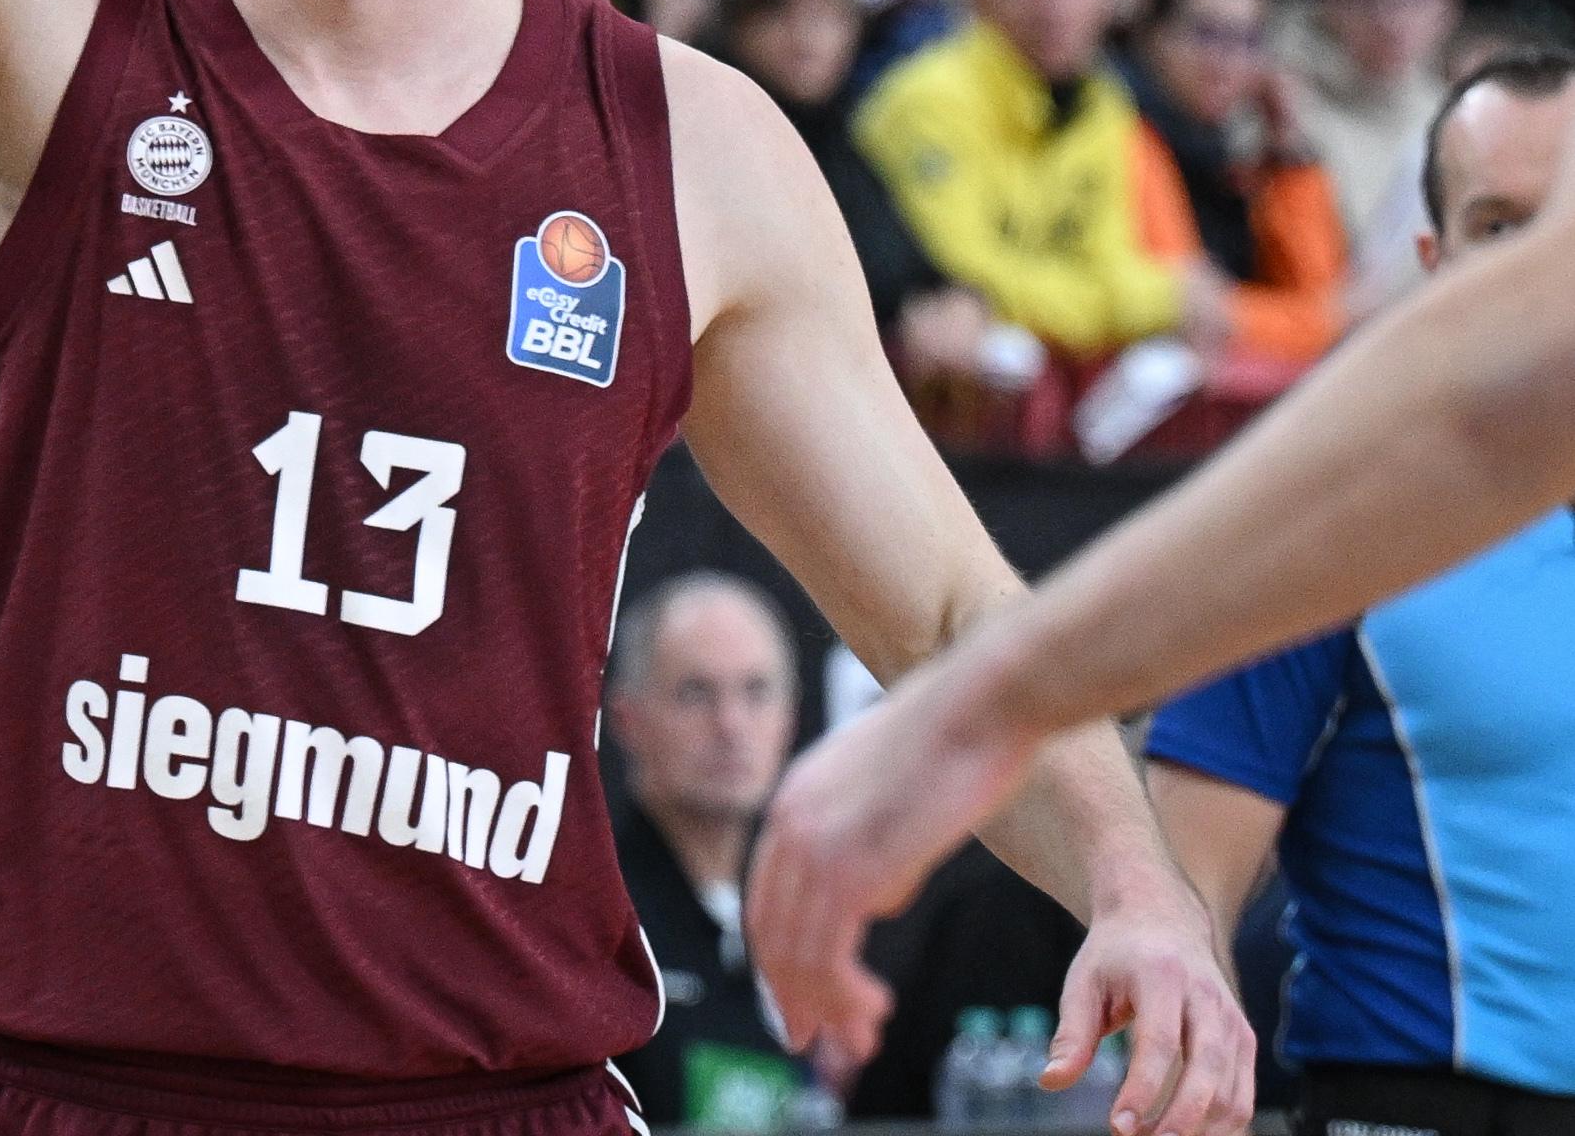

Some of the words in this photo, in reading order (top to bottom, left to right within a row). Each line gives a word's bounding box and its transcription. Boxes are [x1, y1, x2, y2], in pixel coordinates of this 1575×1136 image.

[159, 123, 205, 157] BAYERN
[521, 318, 603, 370] BBL
[549, 305, 608, 336] Credit
[235, 410, 467, 636] 13
[62, 653, 571, 885] siegmund
